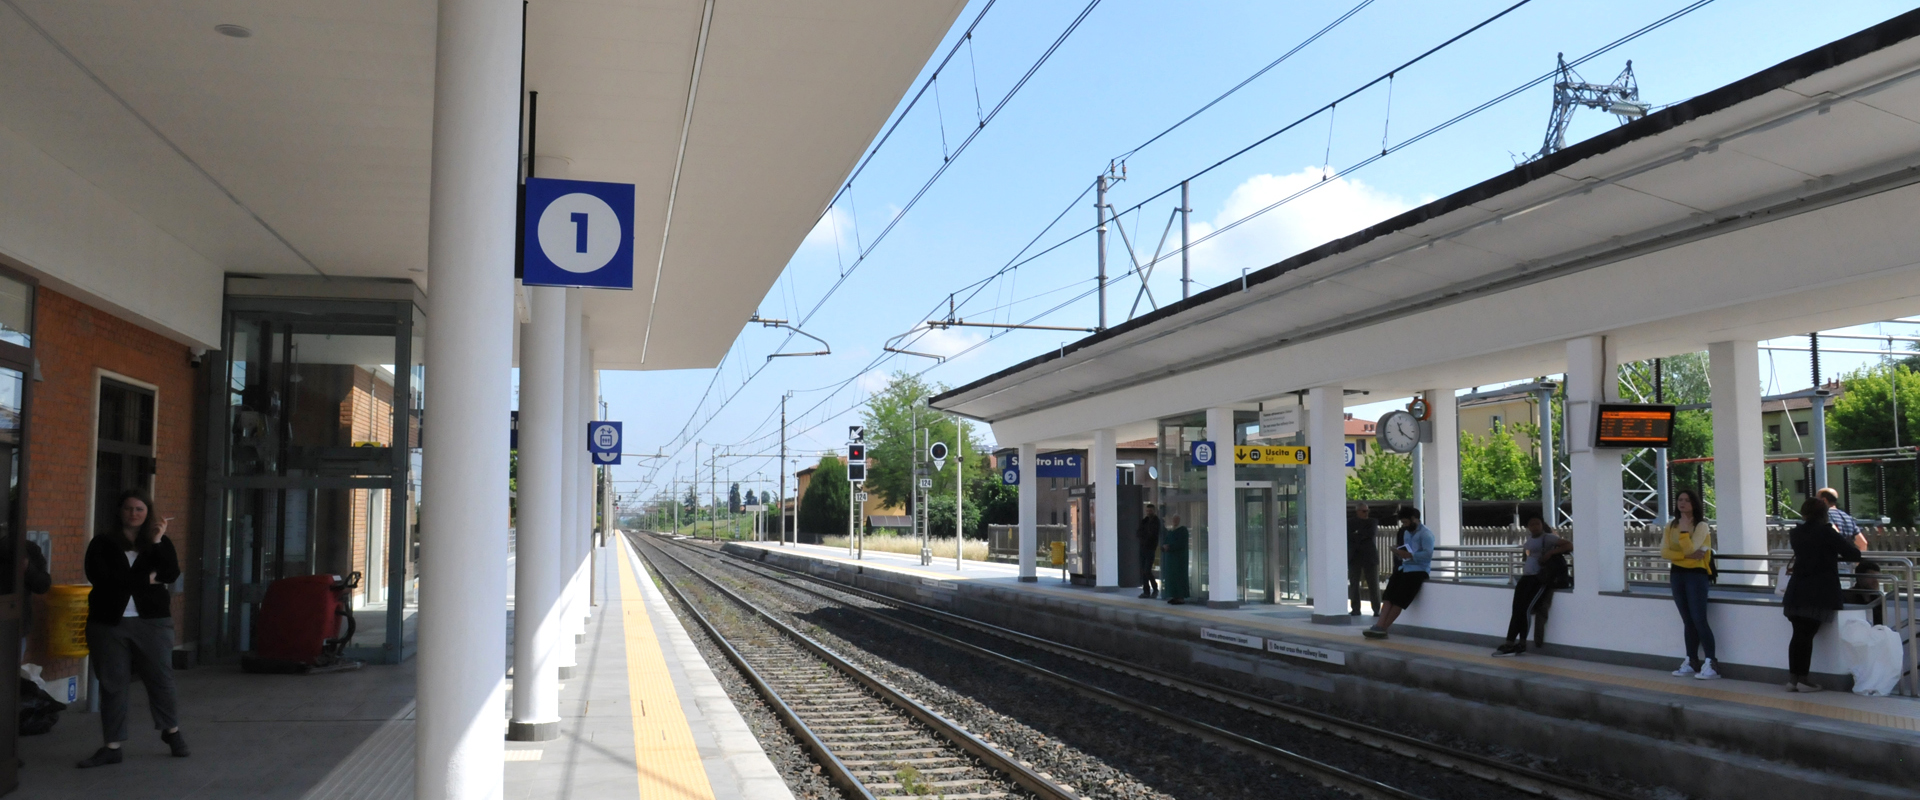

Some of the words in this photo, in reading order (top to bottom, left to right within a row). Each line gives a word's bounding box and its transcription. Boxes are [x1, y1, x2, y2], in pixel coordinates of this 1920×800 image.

[570, 212, 588, 253] 1
[1054, 457, 1064, 466] in
[1066, 457, 1076, 466] C.
[1303, 649, 1317, 658] railway
[1318, 651, 1328, 659] lines
